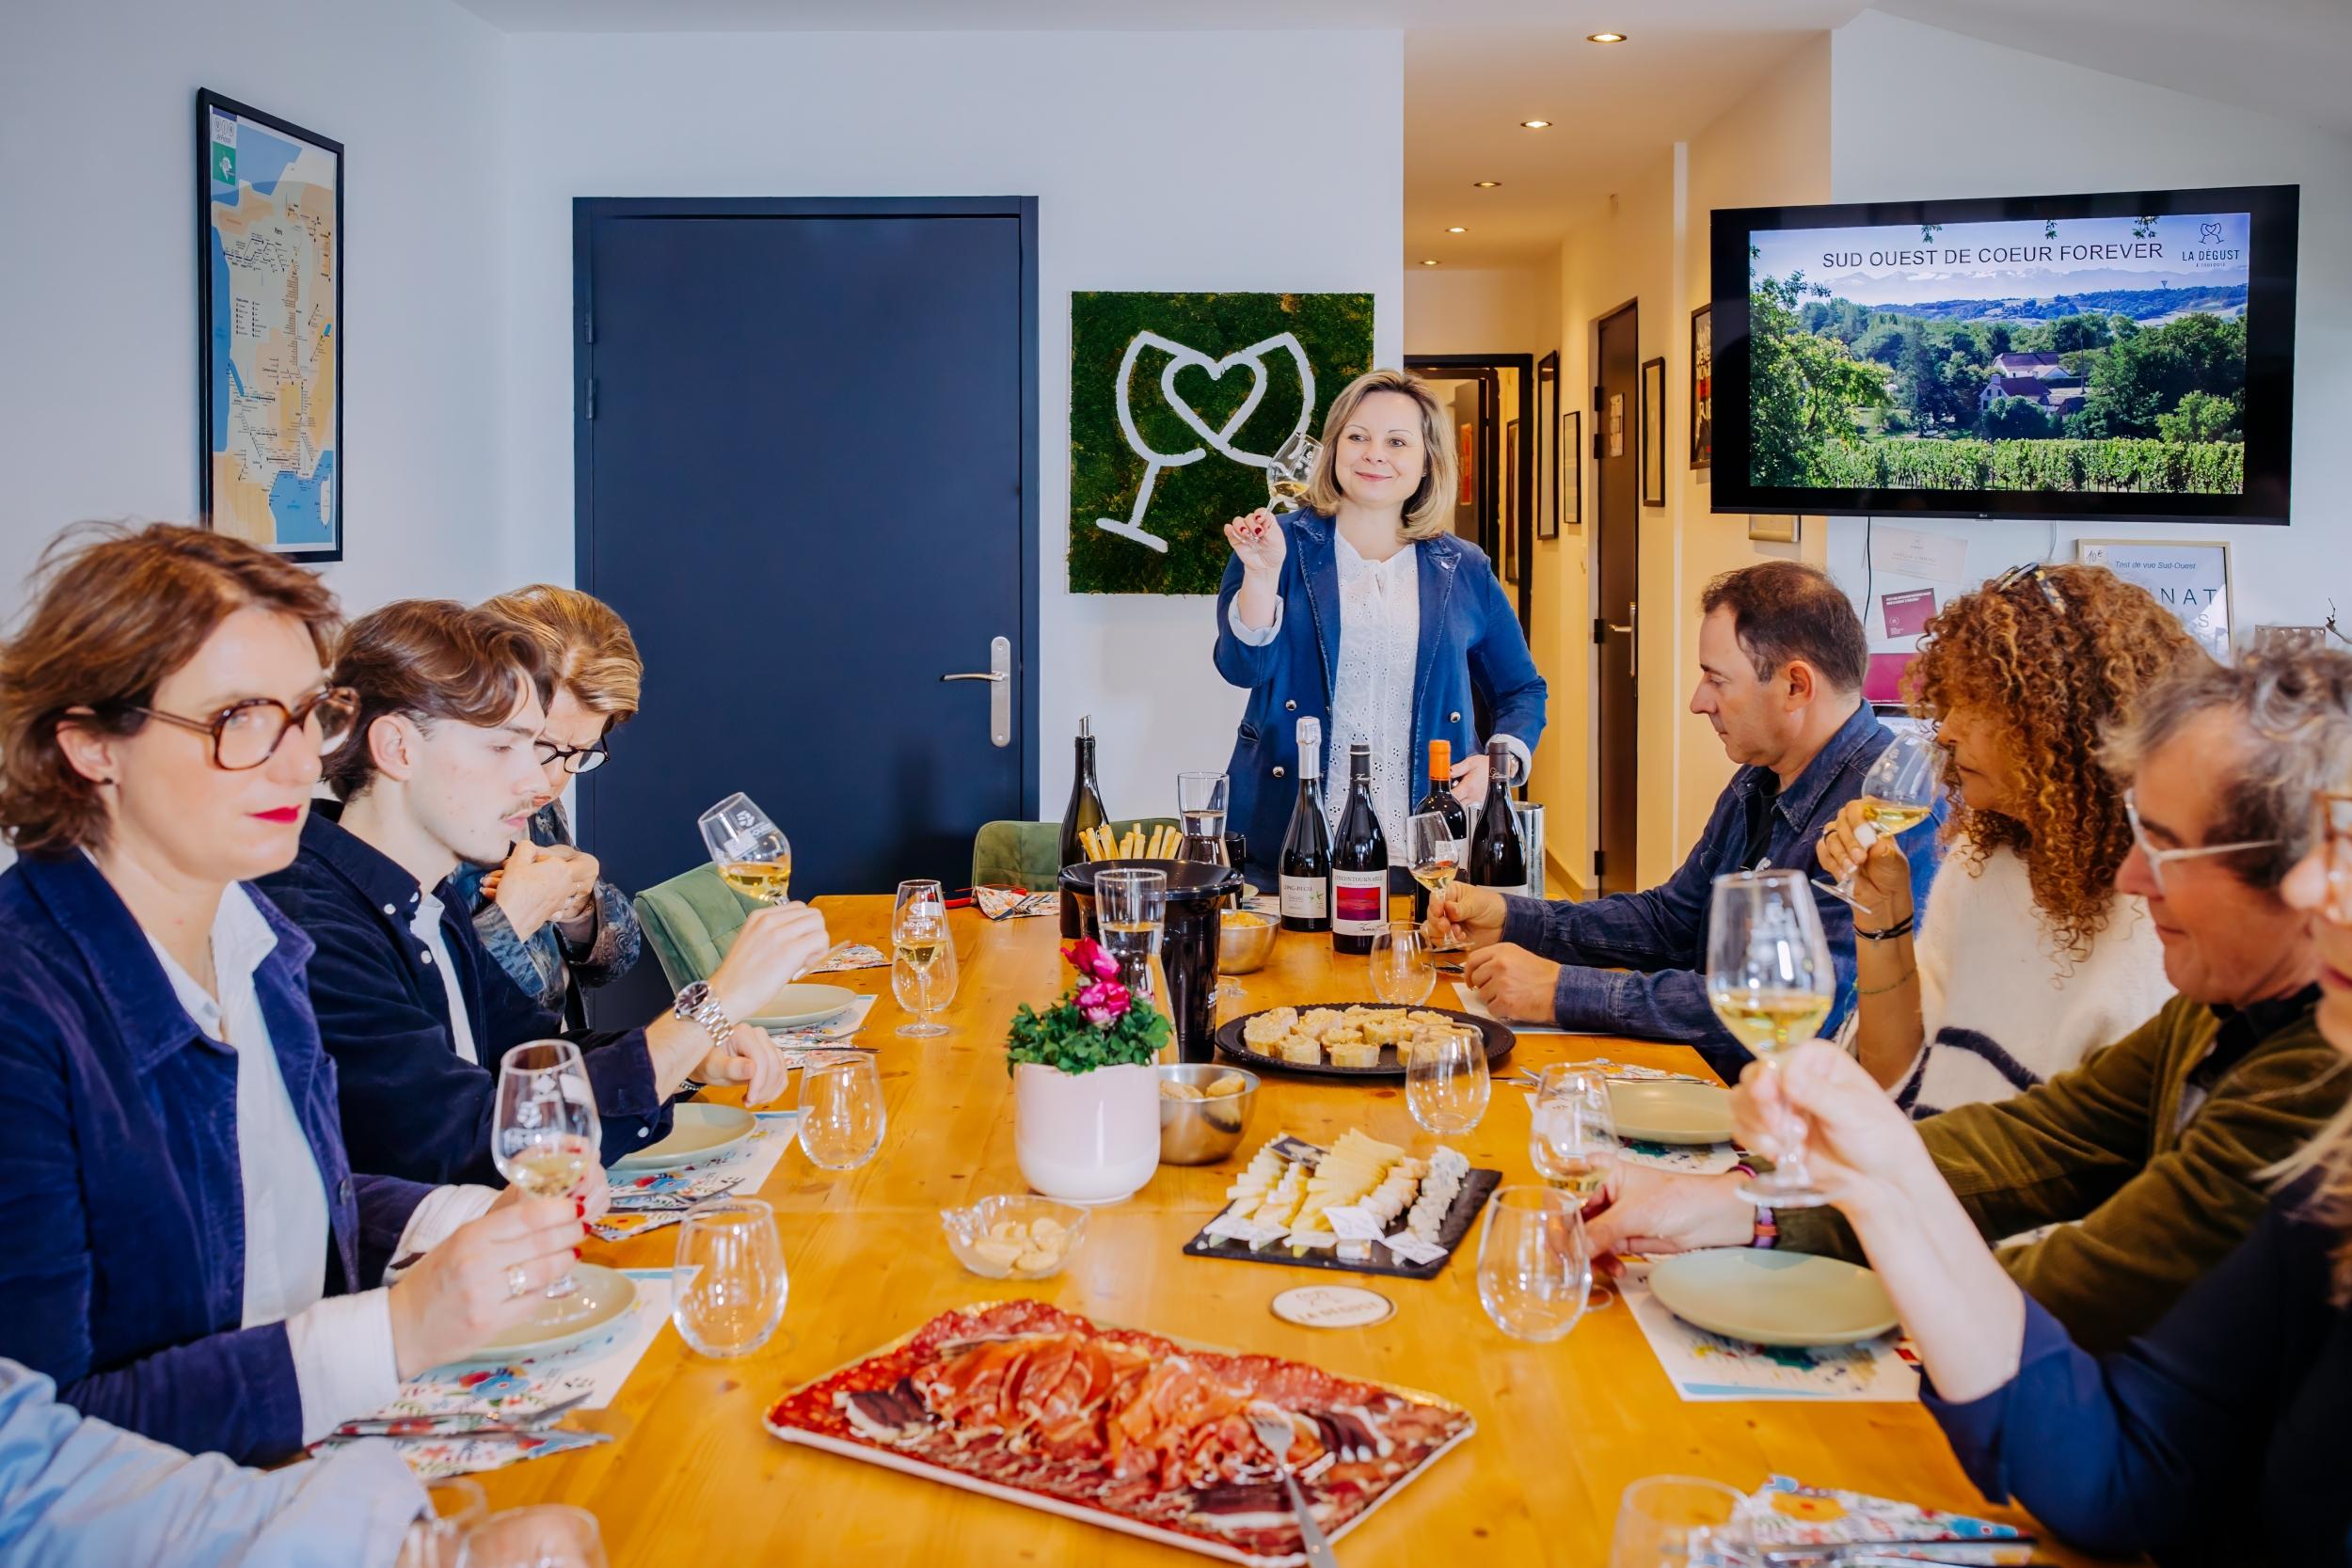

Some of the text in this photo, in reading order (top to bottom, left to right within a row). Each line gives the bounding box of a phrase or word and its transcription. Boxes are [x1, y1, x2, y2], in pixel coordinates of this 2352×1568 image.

[1822, 243, 2164, 268] SUD OUEST DE COEUR FOREVER
[2182, 248, 2240, 261] LA DÉGUST
[2116, 561, 2131, 569] Test
[2158, 562, 2197, 570] Sud-Ouest
